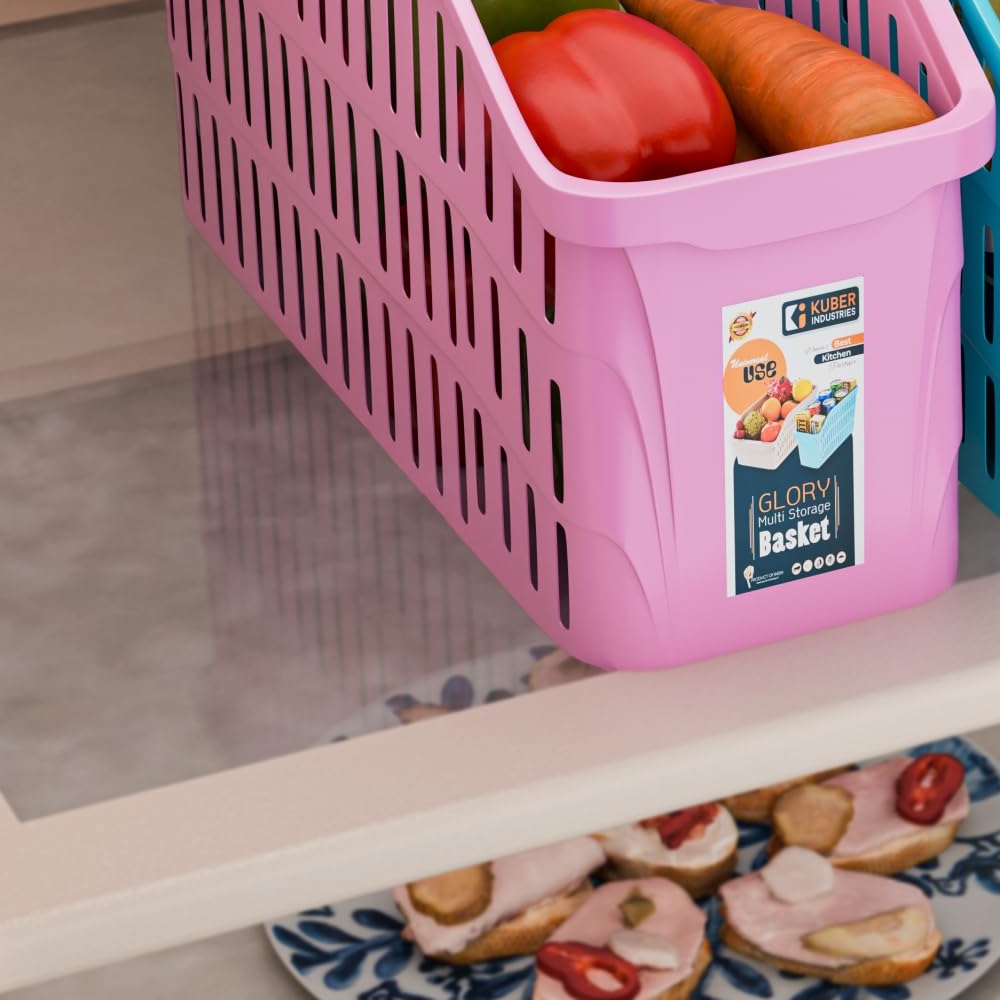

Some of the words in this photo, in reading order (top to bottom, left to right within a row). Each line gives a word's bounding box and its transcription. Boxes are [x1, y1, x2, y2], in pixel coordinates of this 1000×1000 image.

[811, 292, 856, 315] KUBER
[811, 307, 856, 325] INDUSTRIES
[834, 338, 851, 347] Best
[822, 349, 851, 362] Kitchen
[758, 477, 831, 513] GLORY
[758, 511, 785, 529] Multi
[788, 501, 831, 520] Storage
[759, 514, 831, 558] Basket
